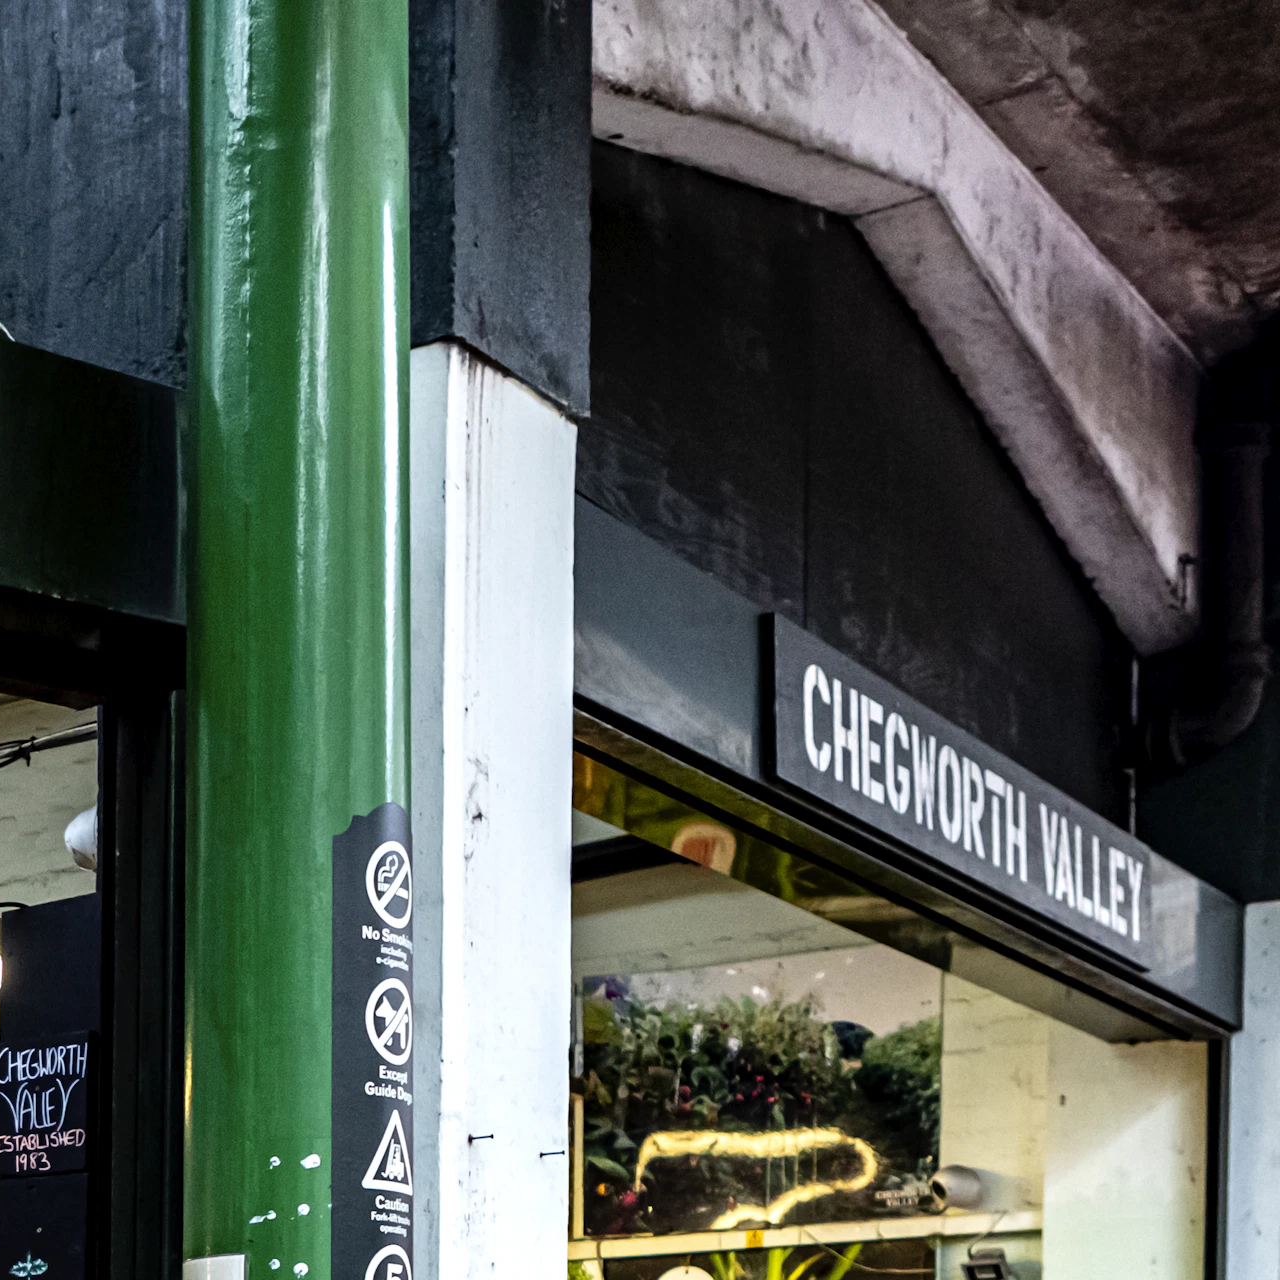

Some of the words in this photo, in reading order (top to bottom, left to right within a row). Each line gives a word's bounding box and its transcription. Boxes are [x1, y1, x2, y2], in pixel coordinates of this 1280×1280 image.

[803, 664, 1028, 883] CHEGWORTH
[1040, 803, 1144, 944] VALLEY
[362, 925, 380, 941] No
[379, 1065, 408, 1084] Except
[364, 1082, 397, 1099] Guide
[0, 1078, 80, 1133] VALLEY
[16, 1152, 51, 1172] 1983
[375, 1195, 409, 1213] Caution
